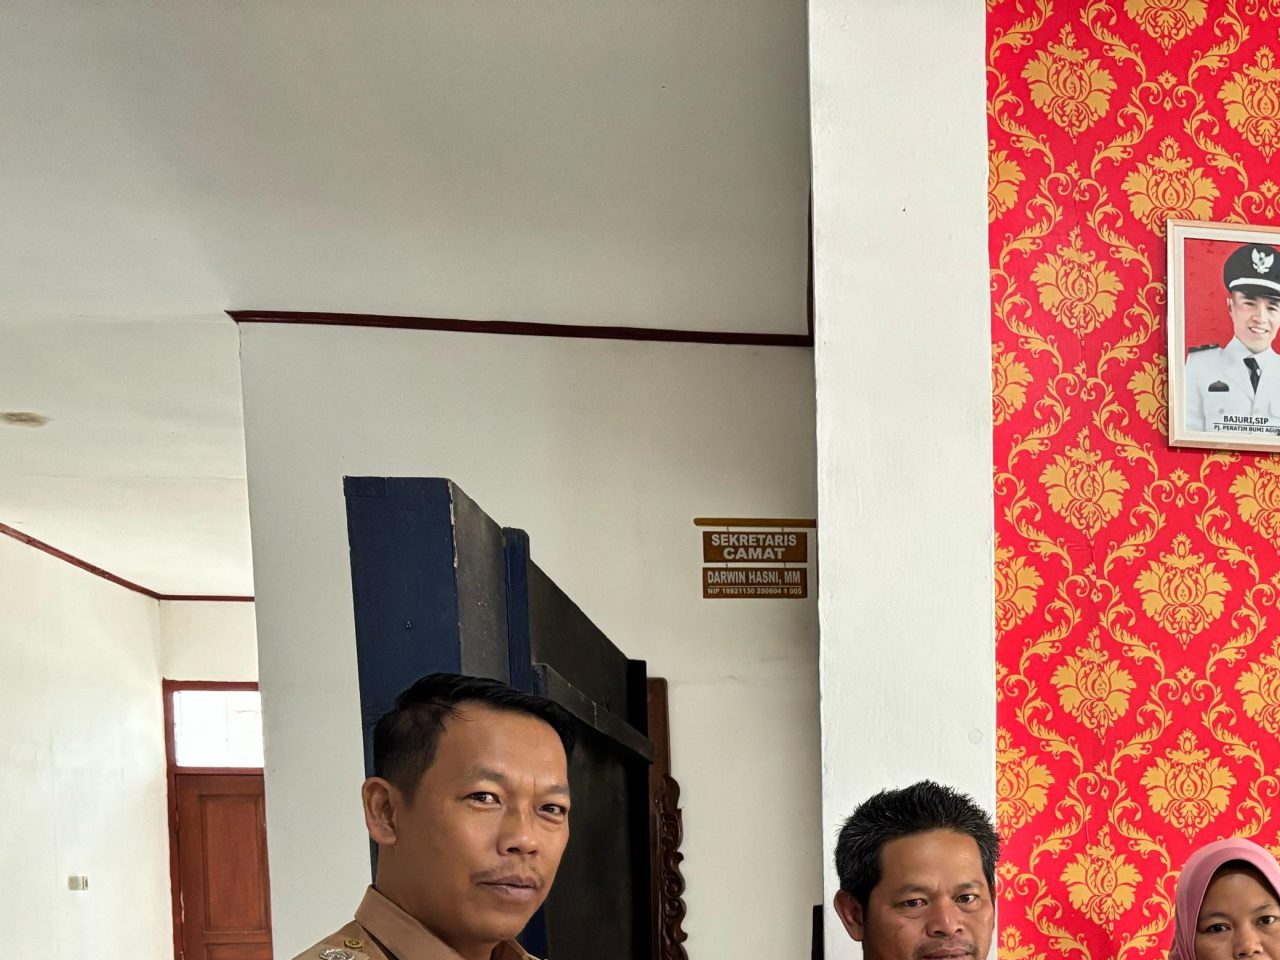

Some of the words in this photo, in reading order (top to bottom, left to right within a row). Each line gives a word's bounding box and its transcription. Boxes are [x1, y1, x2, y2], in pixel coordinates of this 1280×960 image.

[711, 534, 797, 546] SEKRETARIS
[723, 547, 786, 560] CAMAT
[707, 570, 746, 583] DARWIN
[748, 571, 781, 585] HASNI,
[784, 571, 800, 583] MM
